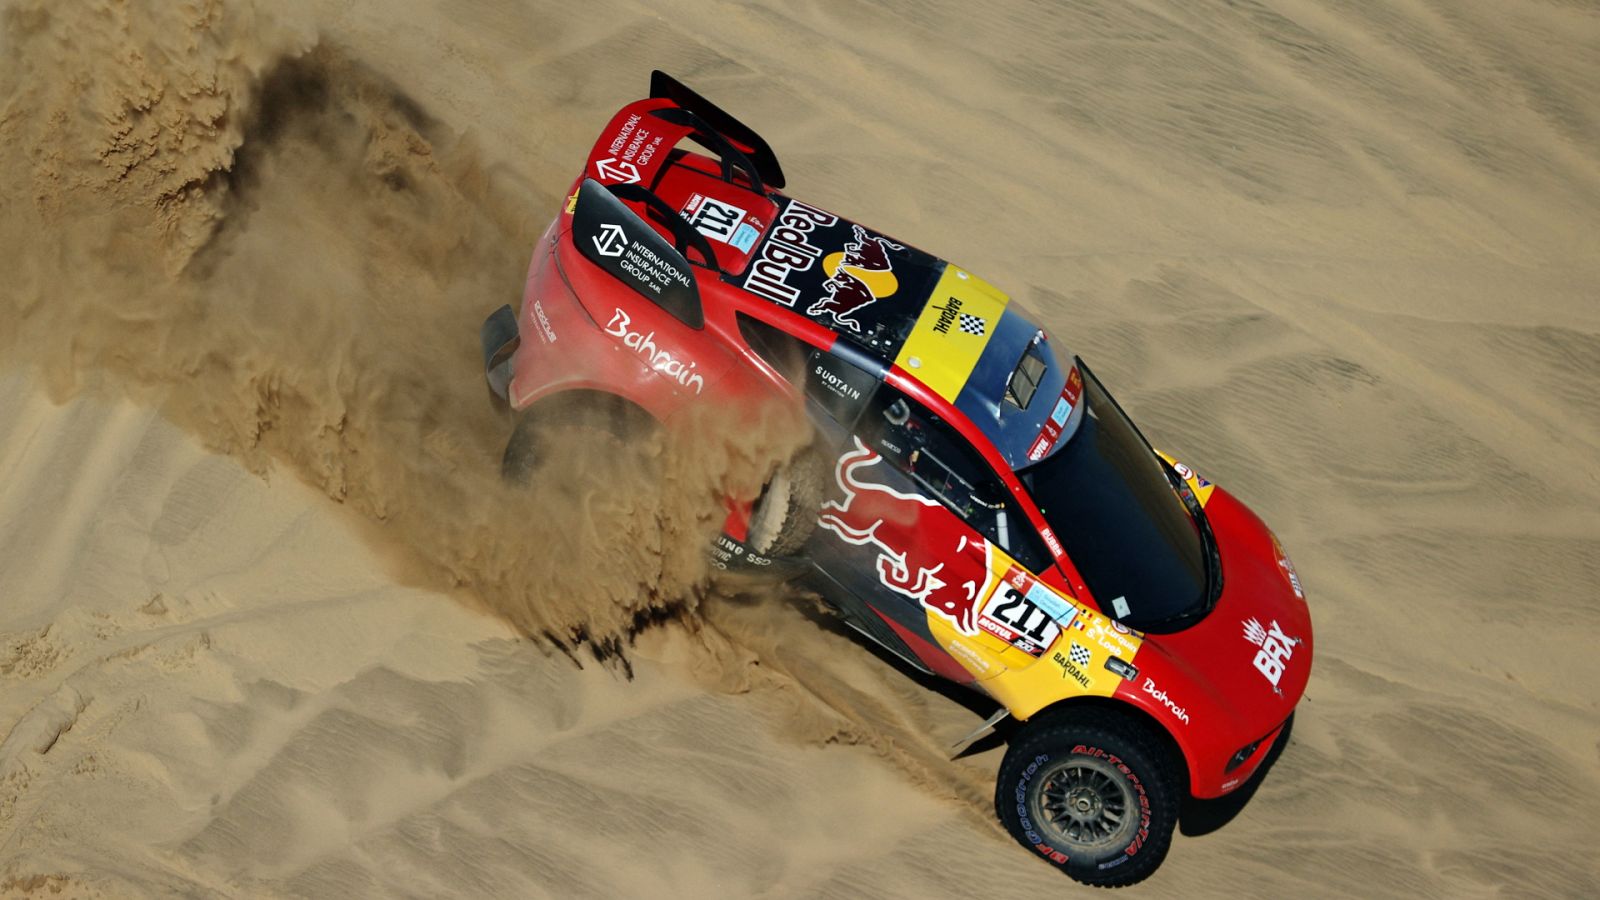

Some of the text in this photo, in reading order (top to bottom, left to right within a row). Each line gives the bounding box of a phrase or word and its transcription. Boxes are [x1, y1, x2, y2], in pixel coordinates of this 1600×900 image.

[608, 113, 642, 156] INTERNATIONAL
[622, 128, 650, 161] INSURANCE
[636, 143, 656, 166] GROUP
[694, 201, 740, 236] 211
[620, 259, 650, 282] GROUP
[625, 249, 672, 287] INSURANCE
[631, 240, 691, 288] INTERNATIONAL
[932, 296, 963, 334] BARDAHL
[603, 307, 704, 394] Bahrain
[1028, 438, 1050, 461] MOTUL
[978, 617, 1012, 641] MOTUL
[991, 588, 1054, 643] 211
[1098, 635, 1122, 656] Loeb
[1252, 619, 1298, 687] BRX
[1053, 651, 1090, 689] BARDAHL
[1142, 676, 1189, 725] Bahrain
